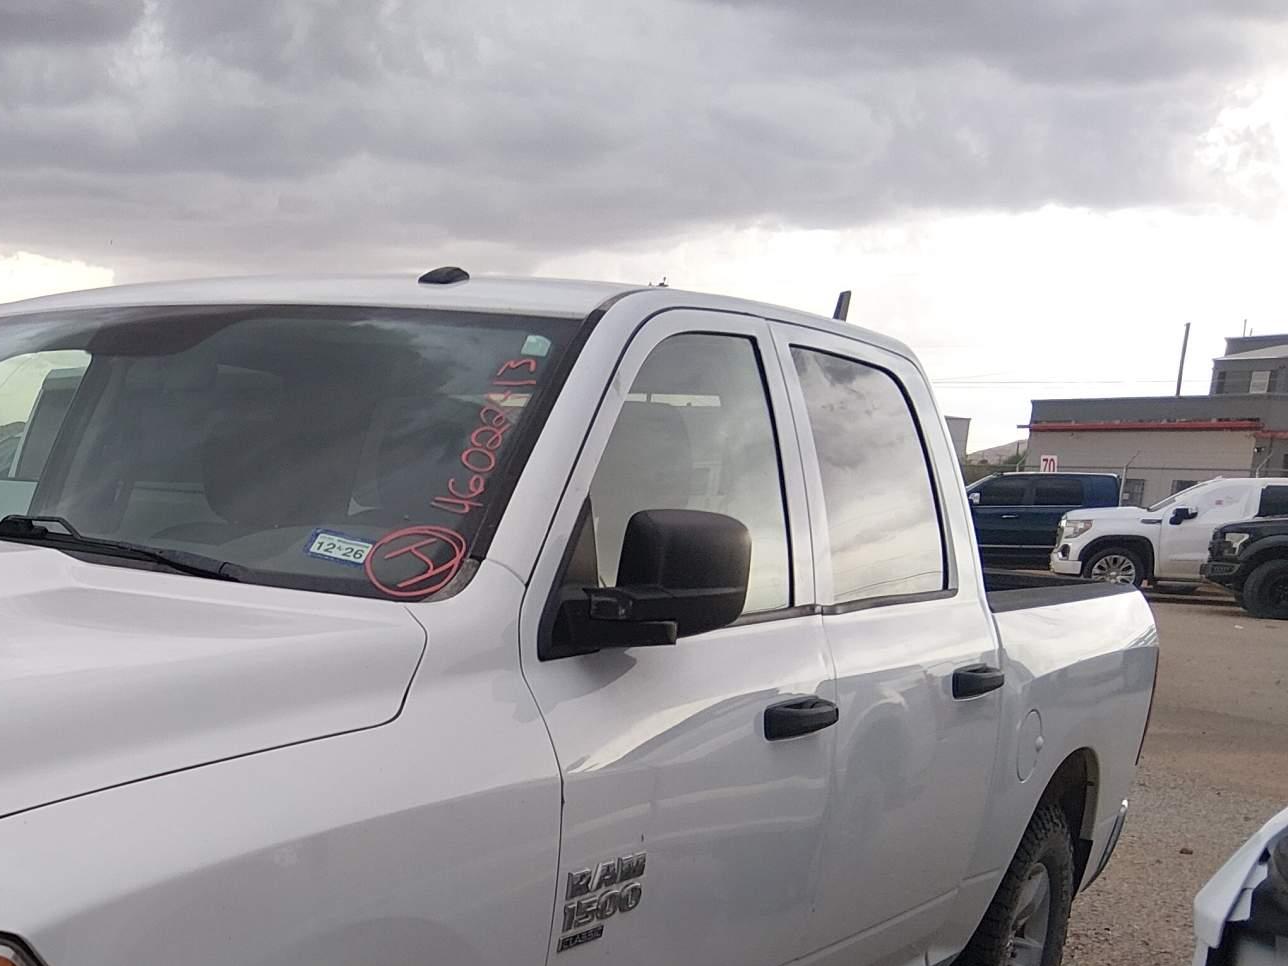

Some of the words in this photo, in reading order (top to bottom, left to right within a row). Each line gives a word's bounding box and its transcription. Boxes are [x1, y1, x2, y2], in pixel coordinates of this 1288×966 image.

[1042, 458, 1056, 473] 70
[316, 540, 337, 554] 12
[342, 546, 365, 560] 26
[565, 851, 647, 900] RAM
[562, 882, 643, 934] 1500
